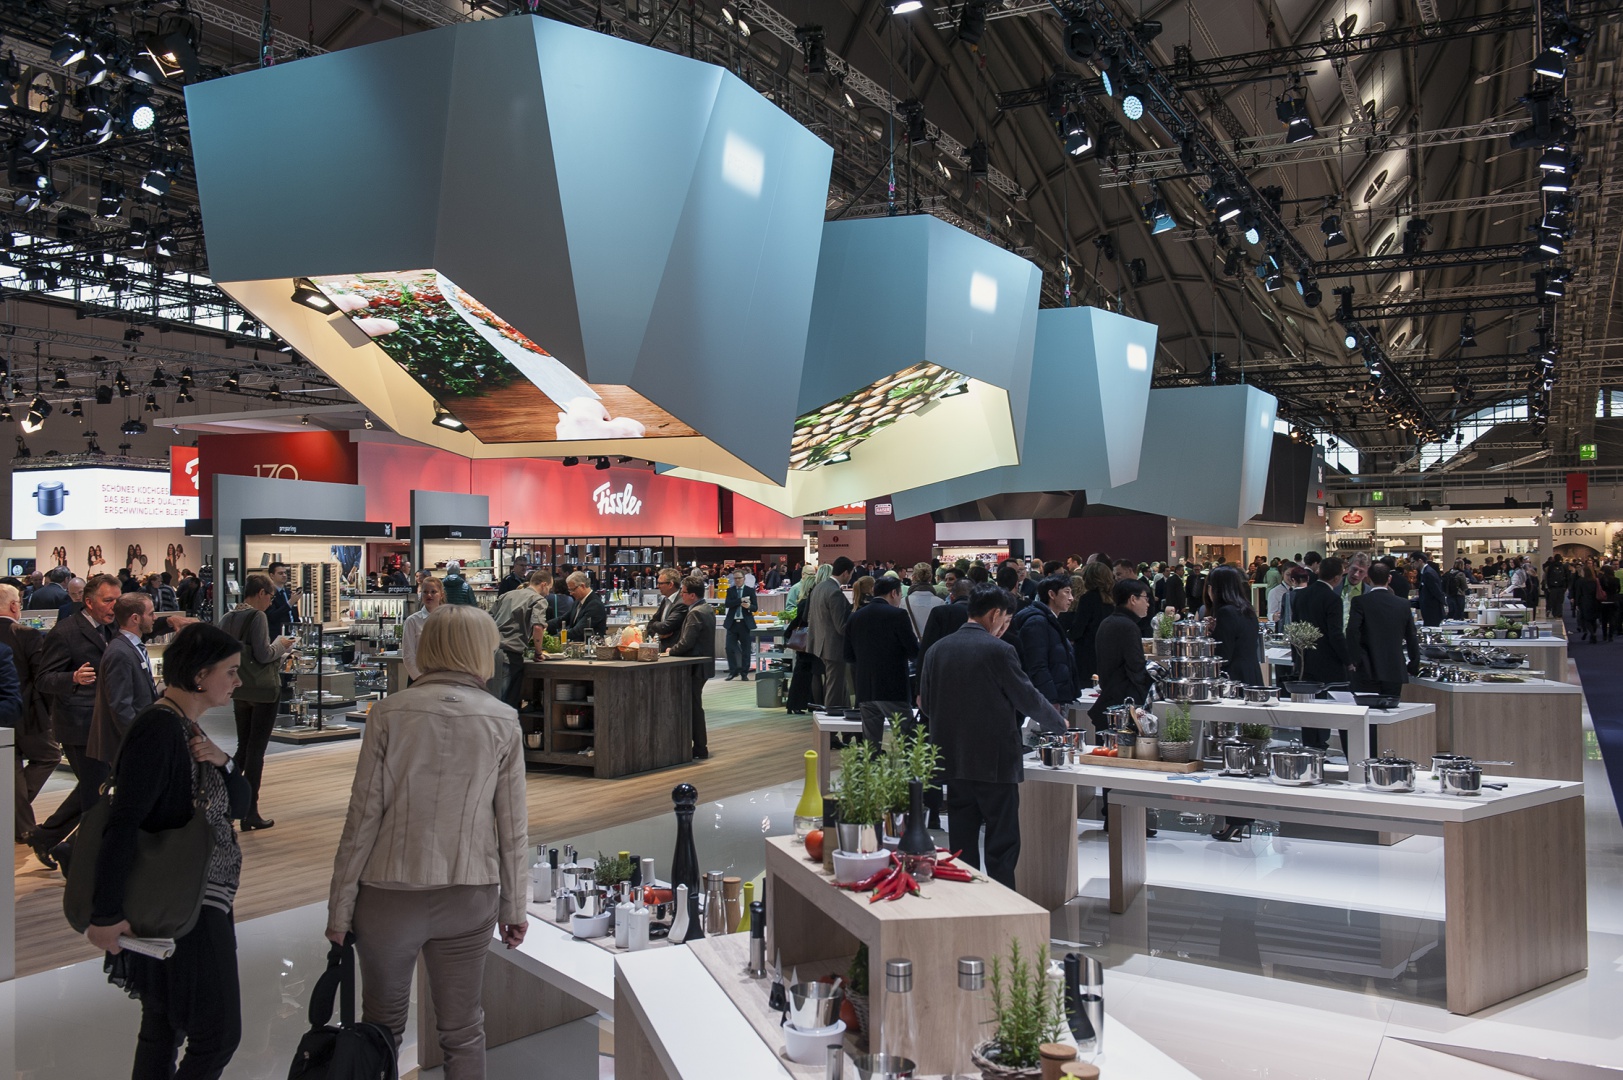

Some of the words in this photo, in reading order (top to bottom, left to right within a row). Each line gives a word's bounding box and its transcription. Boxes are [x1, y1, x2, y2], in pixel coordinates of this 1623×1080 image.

[104, 495, 118, 503] DAS
[121, 496, 131, 504] BEI
[593, 481, 642, 515] Fissler
[1572, 490, 1582, 505] E
[279, 525, 297, 533] preparing
[1552, 528, 1597, 536] UFFONI
[388, 586, 412, 594] preparing
